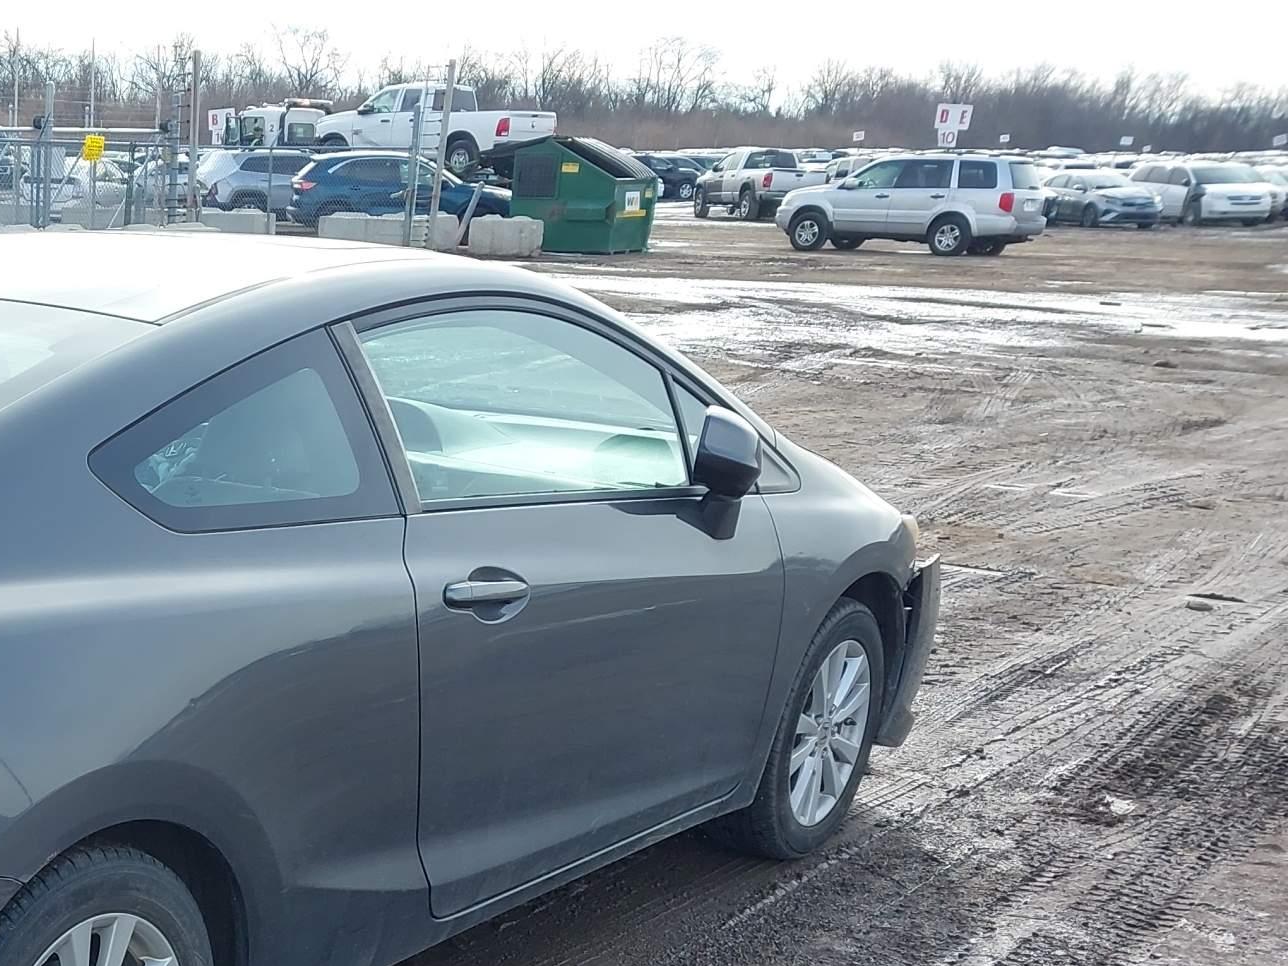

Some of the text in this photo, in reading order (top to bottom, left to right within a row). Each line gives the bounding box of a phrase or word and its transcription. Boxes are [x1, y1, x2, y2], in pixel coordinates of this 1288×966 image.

[211, 113, 219, 126] B
[939, 109, 968, 125] D E
[940, 131, 956, 145] 10
